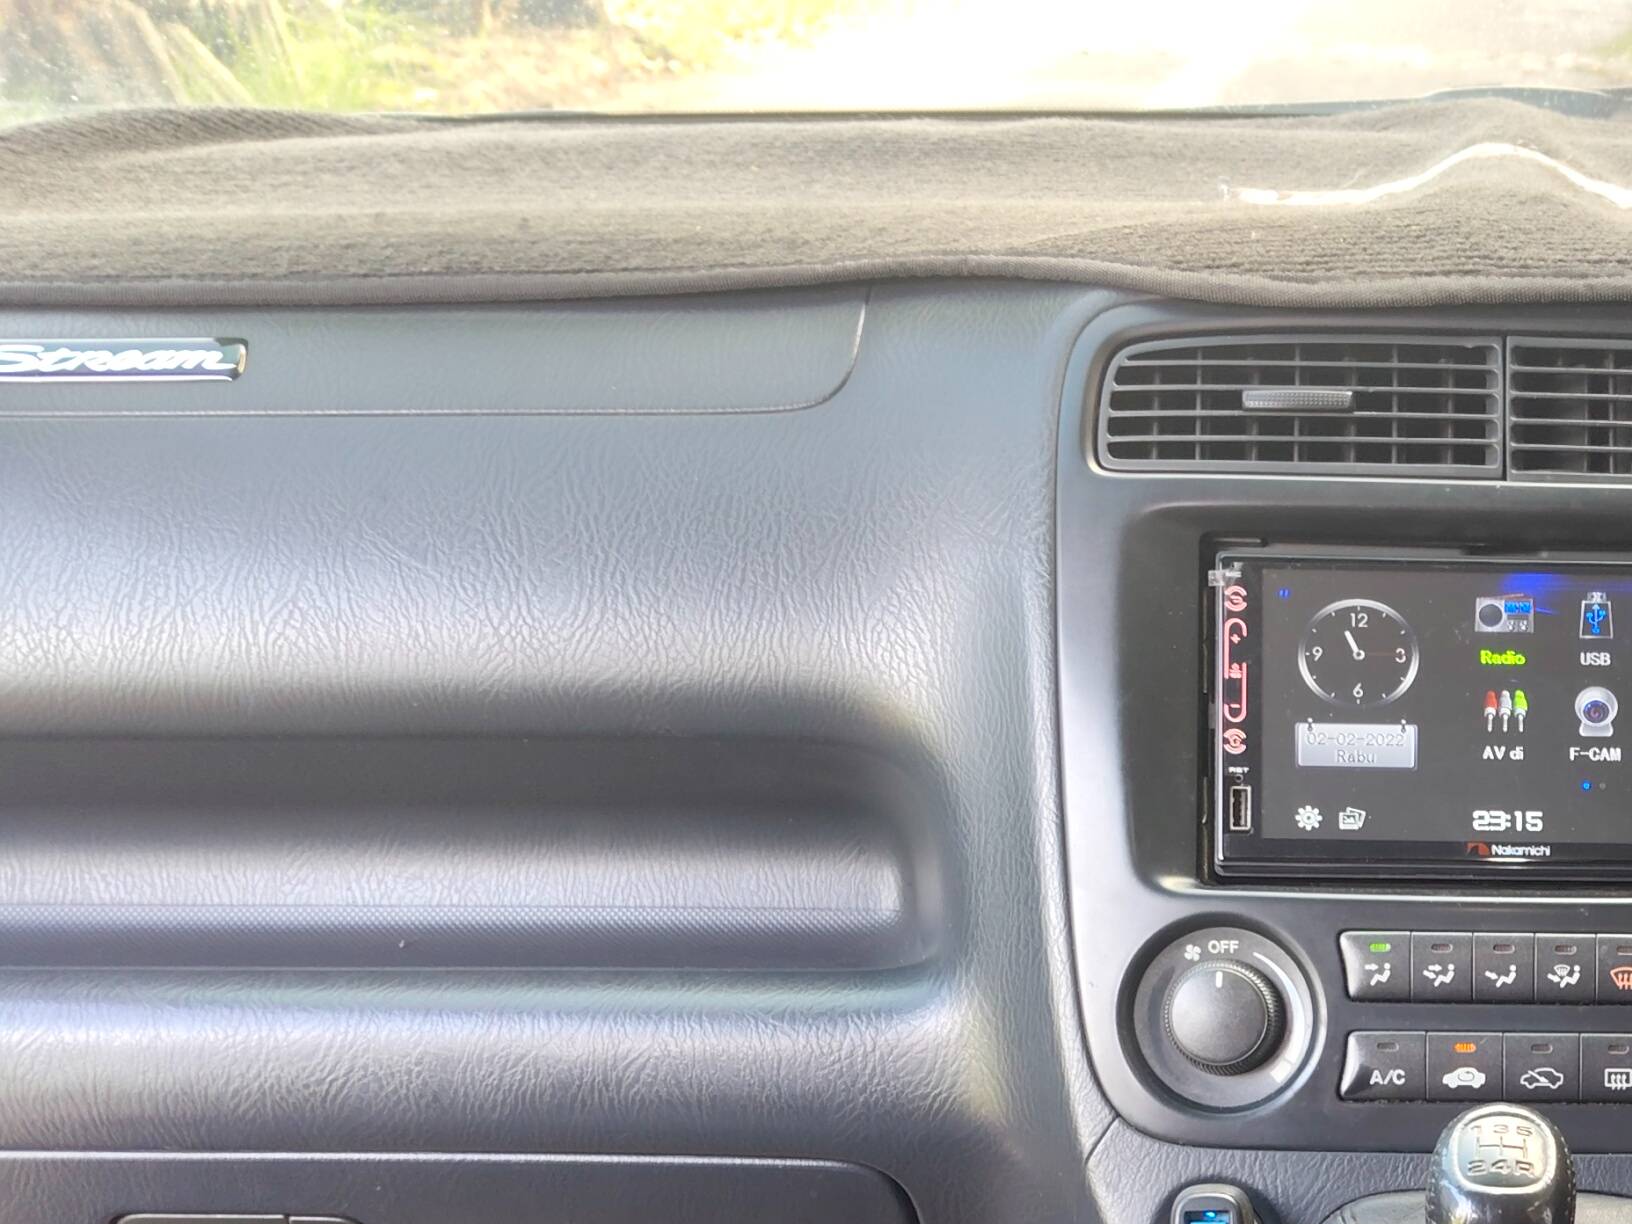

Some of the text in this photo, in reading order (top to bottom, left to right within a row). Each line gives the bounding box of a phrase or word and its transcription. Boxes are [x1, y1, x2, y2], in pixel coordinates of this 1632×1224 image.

[0, 344, 237, 372] Stream
[1350, 613, 1369, 628] 12
[1312, 646, 1323, 661] 9
[1395, 648, 1407, 664] 3
[1480, 650, 1526, 665] Radio
[1580, 652, 1611, 667] USB
[1352, 683, 1364, 698] 6
[1336, 750, 1376, 765] Rabu
[1483, 746, 1524, 760] AV di
[1569, 747, 1622, 762] F-CAM
[1472, 810, 1544, 832] 23:15
[1490, 844, 1551, 857] Nakamichi
[1207, 939, 1240, 954] OFF
[1369, 1069, 1406, 1086] A/C
[1493, 1124, 1509, 1135] 3
[1516, 1125, 1533, 1137] 5
[1467, 1158, 1537, 1178] 2 4 R
